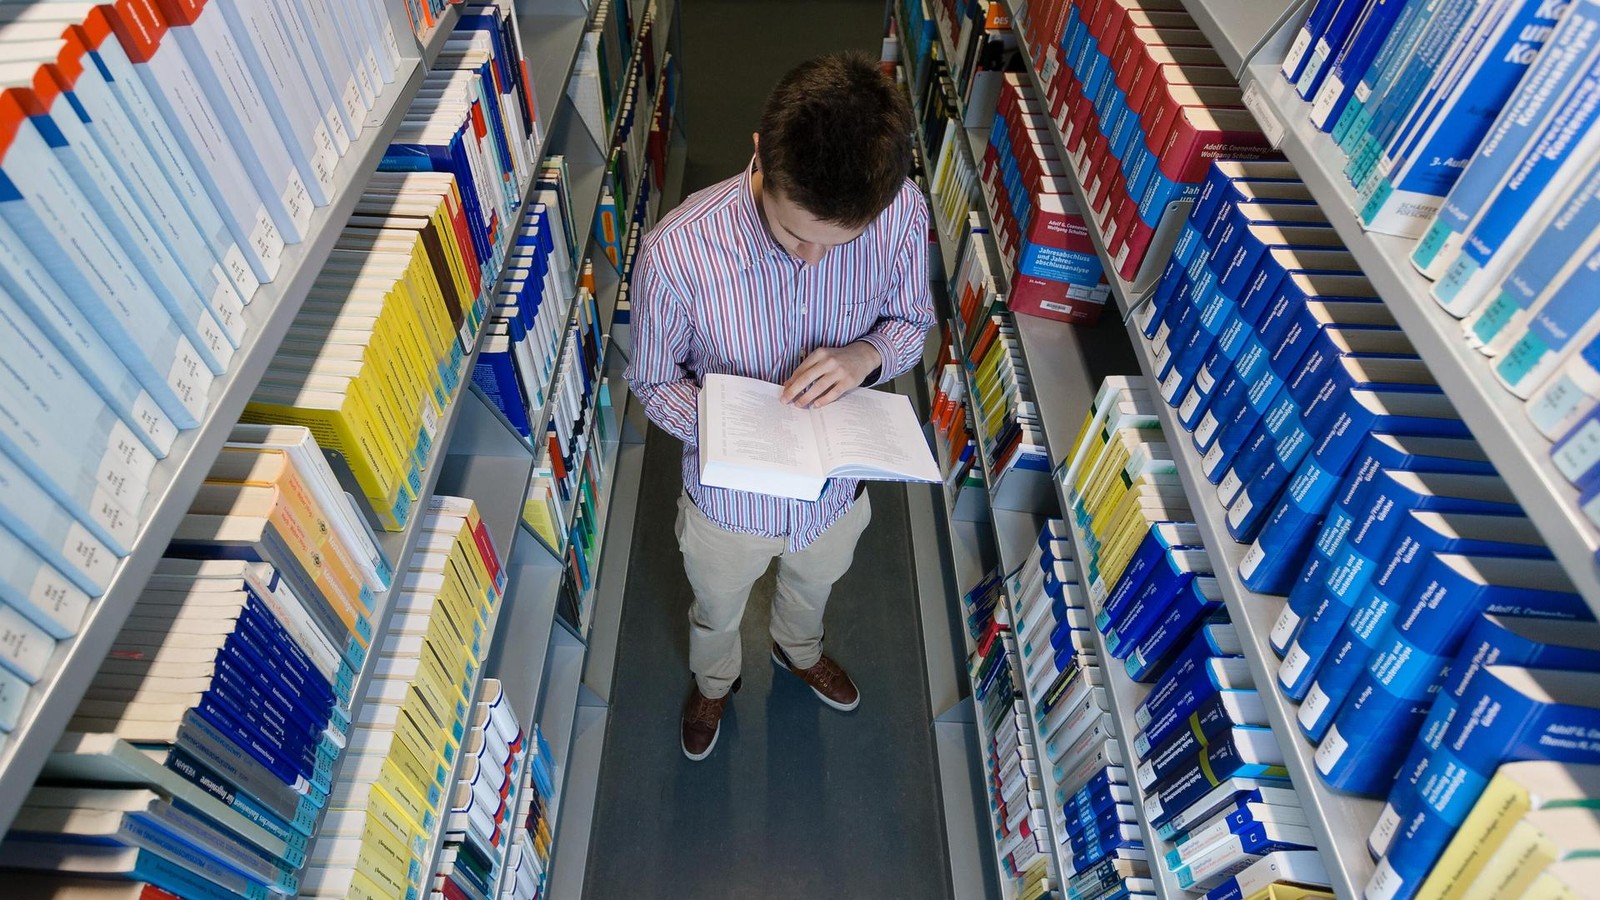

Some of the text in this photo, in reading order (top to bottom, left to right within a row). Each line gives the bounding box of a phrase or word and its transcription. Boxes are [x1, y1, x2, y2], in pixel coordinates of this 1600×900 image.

[1519, 24, 1552, 42] un
[1559, 13, 1584, 46] und
[1544, 86, 1600, 161] Kostenan
[1203, 143, 1223, 151] Adolf
[1429, 157, 1468, 168] 3. Aufl
[1039, 247, 1090, 262] Jahresabschluss
[1035, 259, 1090, 274] abschlussanalyse
[1307, 465, 1315, 475] und
[1295, 467, 1320, 502] Kostenanalyse
[1336, 515, 1344, 528] und
[1326, 519, 1352, 556] Kostenanalyse
[1347, 554, 1356, 567] und
[1337, 558, 1364, 596] Kostenanalyse
[1370, 596, 1380, 609] und
[1360, 599, 1389, 639] Kostenanalyse
[1393, 641, 1403, 655] und
[1382, 643, 1412, 685] Kostenanalyse
[1447, 708, 1456, 722] und
[1445, 762, 1456, 777] und
